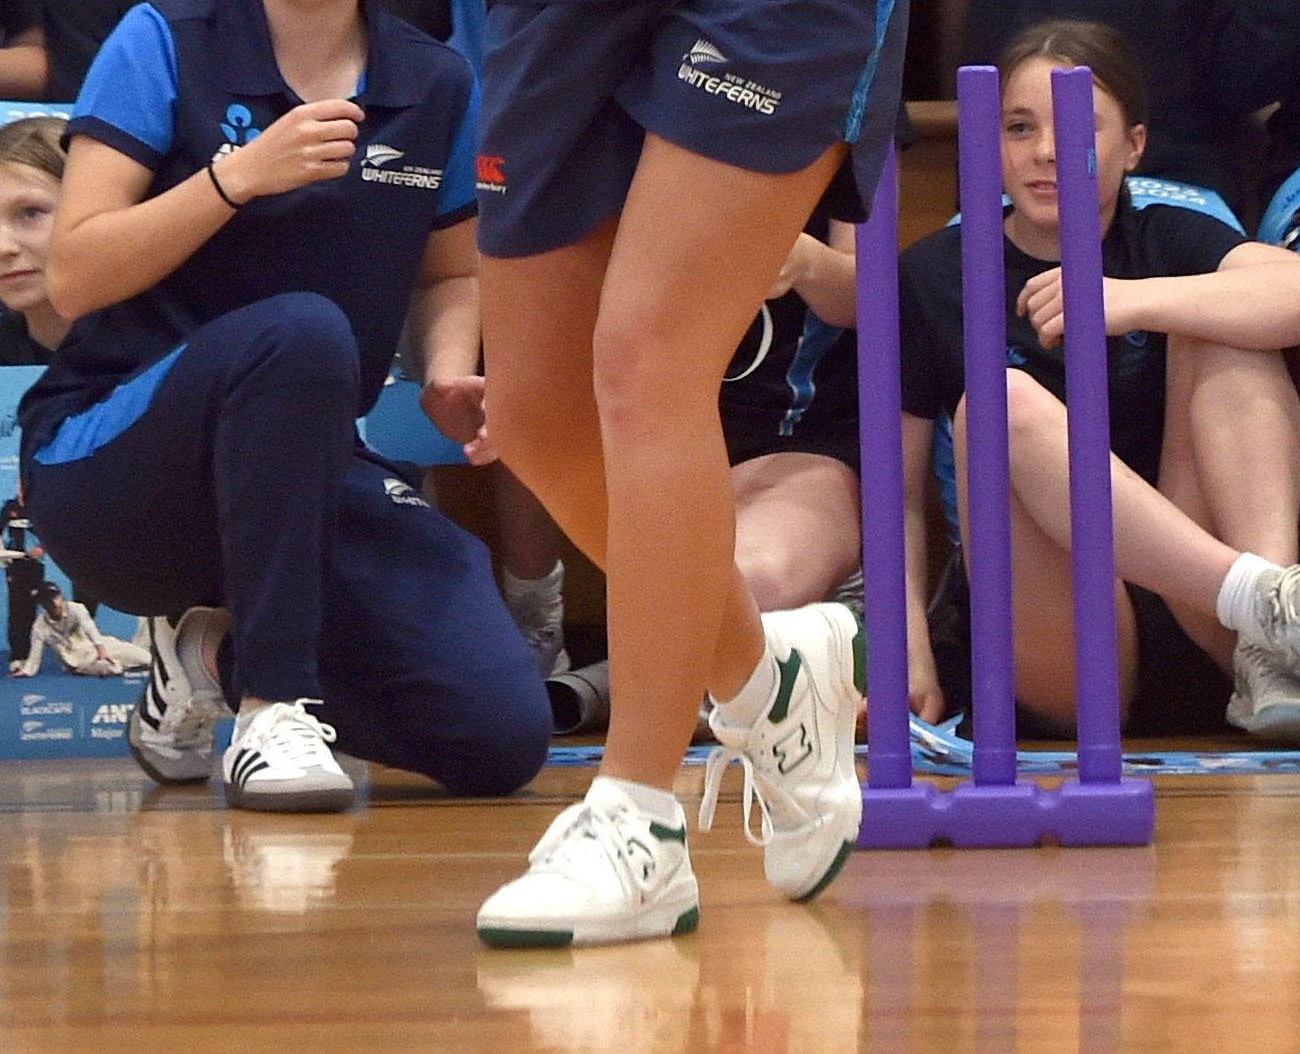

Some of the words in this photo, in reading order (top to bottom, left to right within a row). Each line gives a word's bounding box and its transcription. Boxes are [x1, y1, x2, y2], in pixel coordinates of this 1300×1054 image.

[678, 63, 780, 115] WHITEFERNS
[724, 73, 745, 85] NEW
[744, 80, 782, 99] ZEALAND
[361, 168, 442, 189] WHITEFERNS
